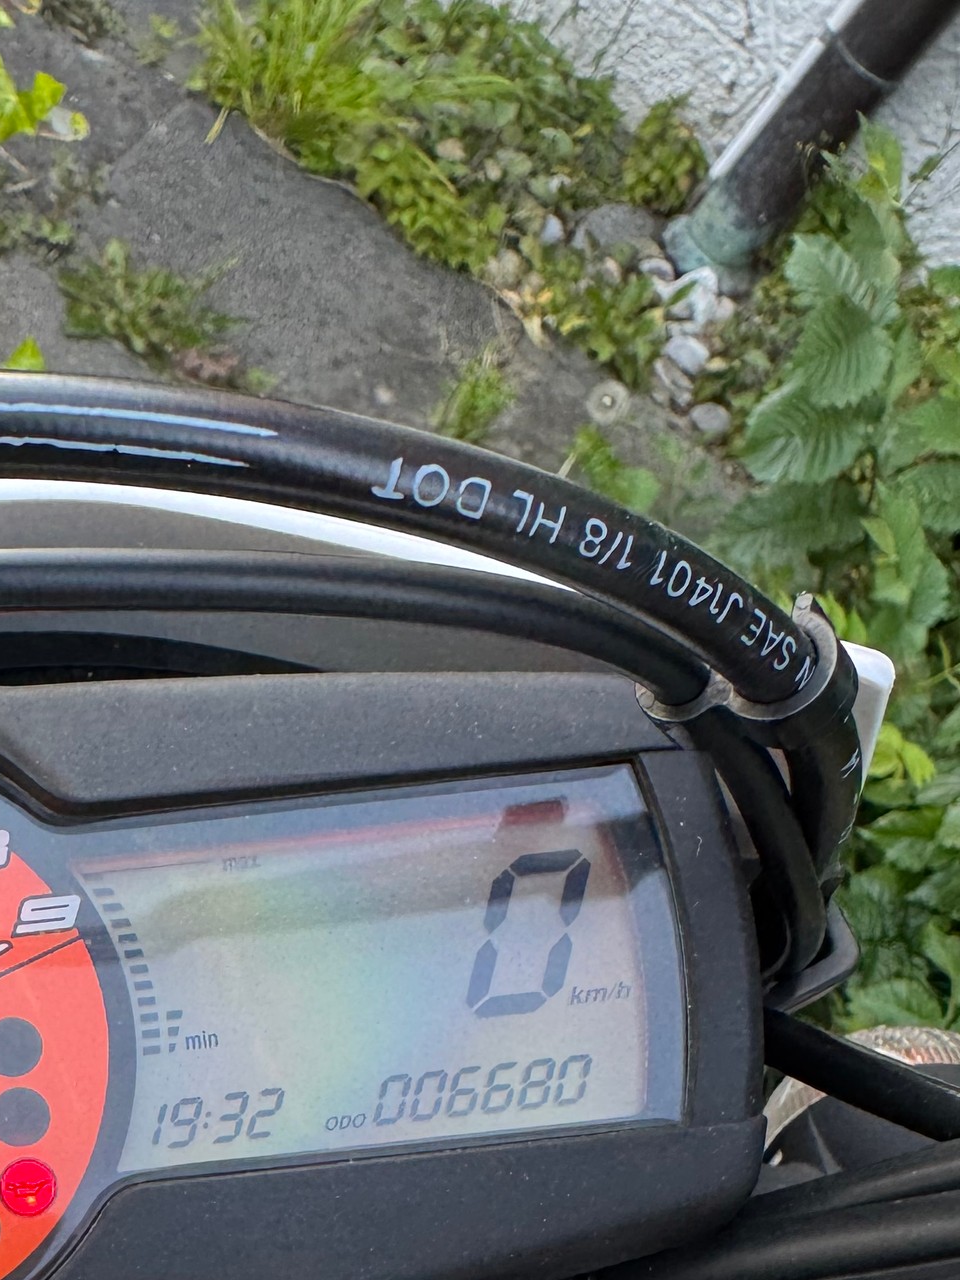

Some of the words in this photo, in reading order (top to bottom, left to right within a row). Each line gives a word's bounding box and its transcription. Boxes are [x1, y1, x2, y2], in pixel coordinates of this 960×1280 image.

[371, 457, 493, 520] DOT
[514, 489, 568, 544] HL
[579, 517, 635, 571] 1/8
[649, 549, 744, 624] J1401
[740, 608, 796, 671] SAE
[13, 894, 81, 936] 9
[465, 849, 591, 1019] 0
[569, 981, 632, 1006] km/h
[185, 1030, 219, 1050] min
[151, 1087, 286, 1149] 19:32
[324, 1113, 367, 1131] ODO
[372, 1053, 592, 1127] 006680
